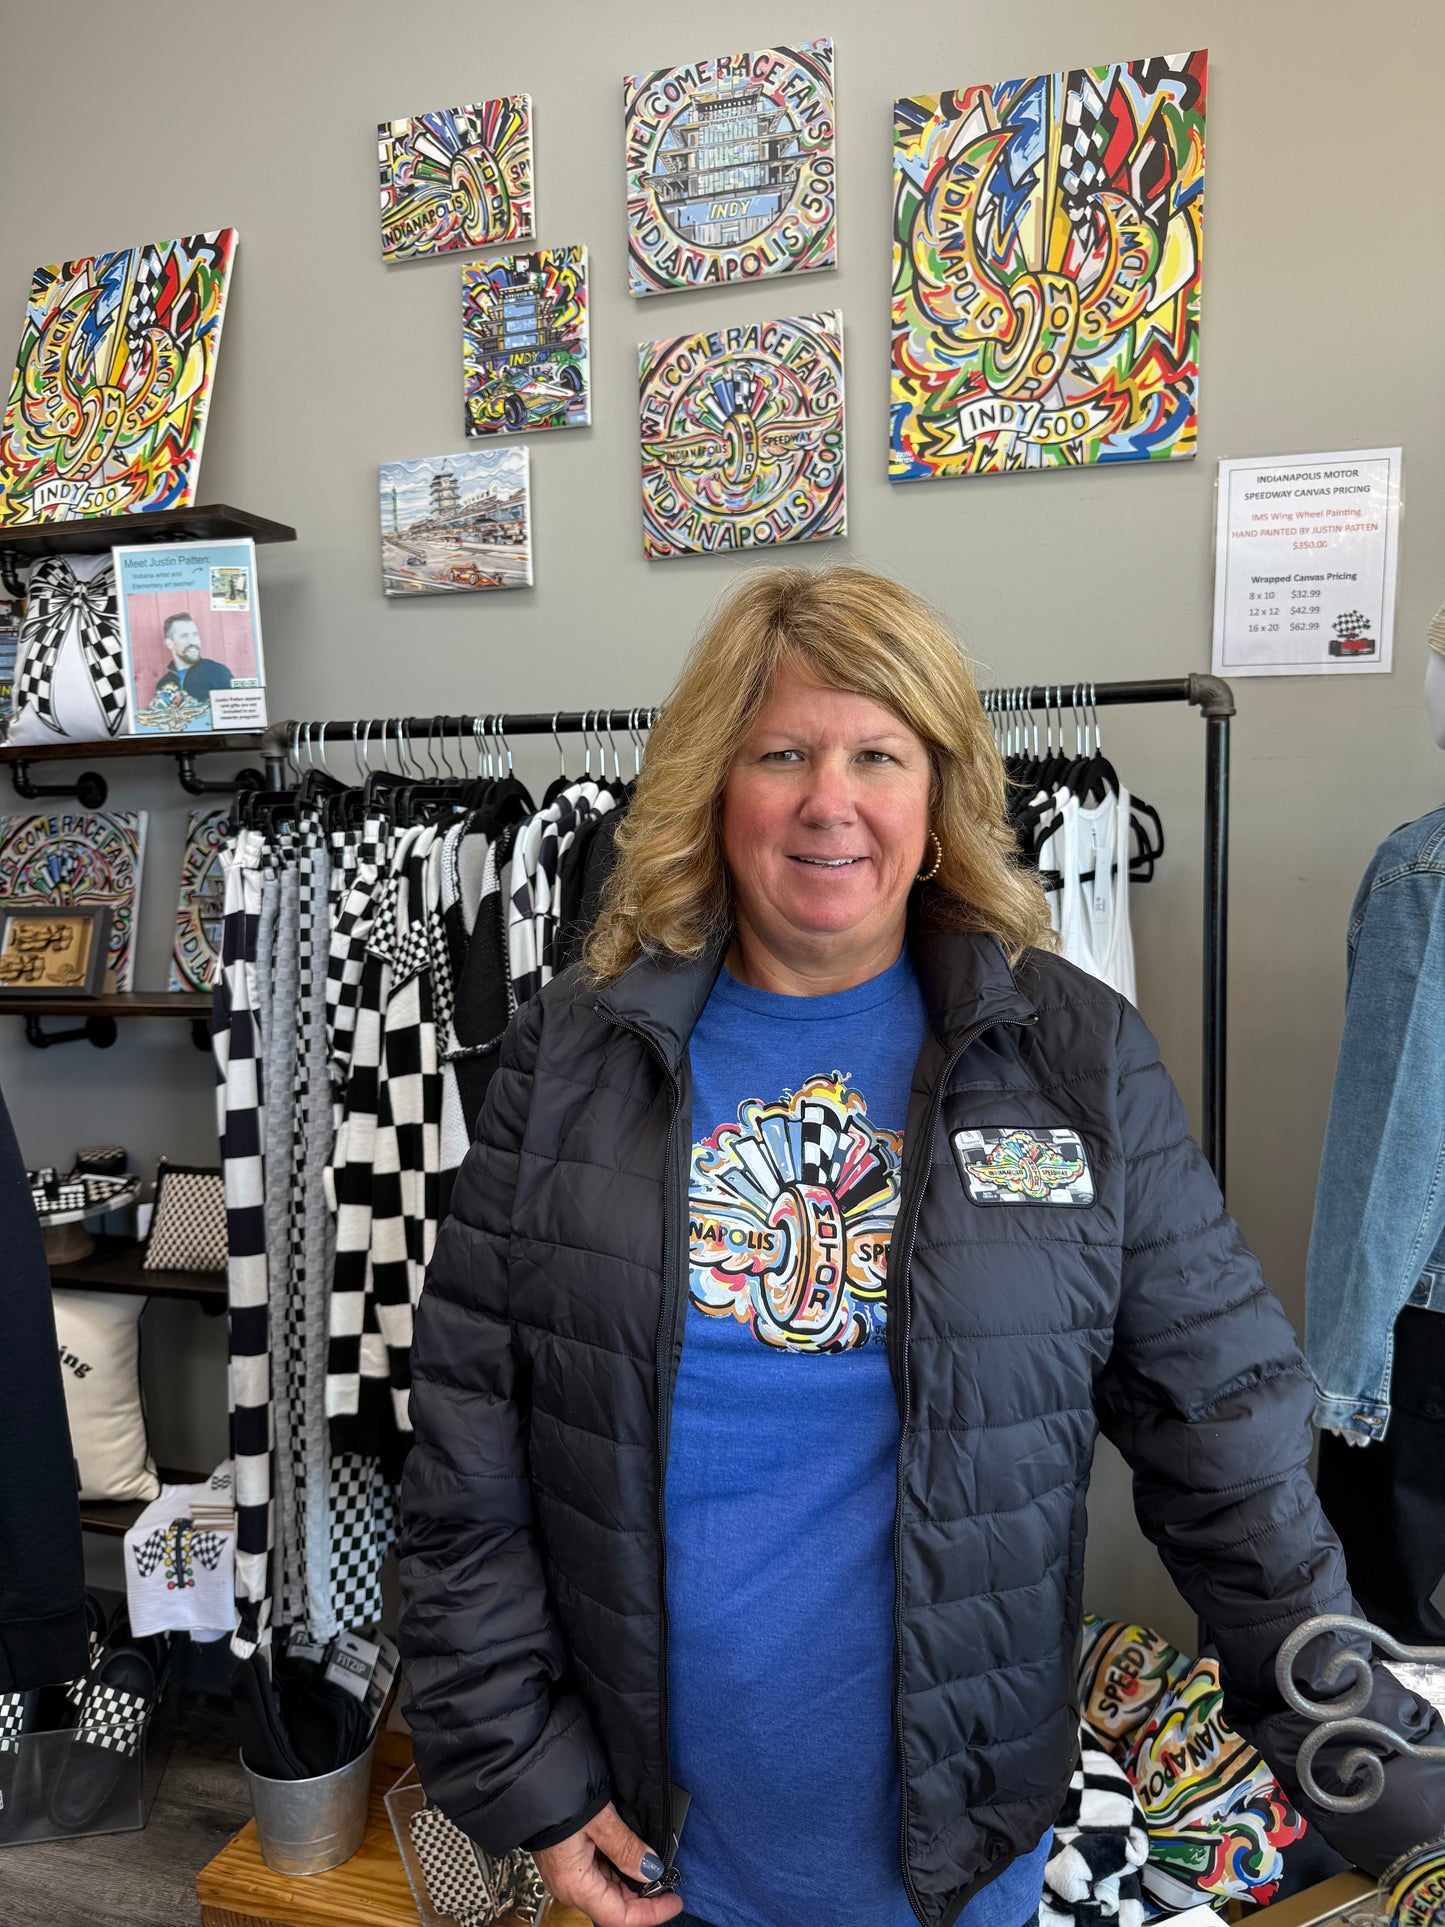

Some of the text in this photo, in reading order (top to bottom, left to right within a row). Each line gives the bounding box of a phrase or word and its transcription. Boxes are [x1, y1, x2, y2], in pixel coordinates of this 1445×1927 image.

[627, 52, 832, 171] WELCOME RACE FANS
[510, 159, 530, 183] SP
[474, 152, 508, 230] MOTOR
[382, 195, 464, 245] INDIANAPOLIS
[628, 157, 834, 282] INDIANAPOLIS 500
[709, 200, 751, 220] INDY
[937, 161, 1004, 329] INDIANAPOLIS
[1083, 201, 1145, 334] SPEEDWAY
[1016, 282, 1073, 396] MOTOR
[41, 311, 75, 428] INDIANAPOLIS
[509, 351, 541, 367] INDY
[127, 333, 175, 431] SPEEDWAY
[641, 325, 841, 437] WELCOME RACE FANS
[76, 391, 122, 478] MOTOR
[969, 403, 1088, 437] INDY 500
[762, 432, 812, 447] SPEEDWAY
[642, 430, 842, 549] INDIANAPOLIS 500
[1256, 469, 1359, 484] INDIANAPOLIS MOTOR
[40, 482, 117, 508] INDY 500
[1244, 485, 1371, 501] SPEEDWAY CANVAS PRICING
[1252, 508, 1361, 522] IMS Wing Wheel Painting
[1232, 530, 1257, 538] HAND
[1259, 528, 1297, 537] PAINTED
[1299, 527, 1311, 535] BY
[1312, 525, 1342, 534] JUSTIN
[124, 559, 148, 568] Meet
[149, 558, 176, 567] Justin
[1251, 572, 1357, 584] Wrapped Canvas Pricing
[1291, 590, 1321, 599] $32.99
[1249, 608, 1259, 616] 12
[1269, 608, 1279, 616] 12
[1290, 606, 1320, 615] $42.99
[1268, 624, 1279, 632] 20
[1289, 622, 1319, 631] $62.99
[62, 815, 106, 845] RACE
[811, 1201, 838, 1310] MOTOR
